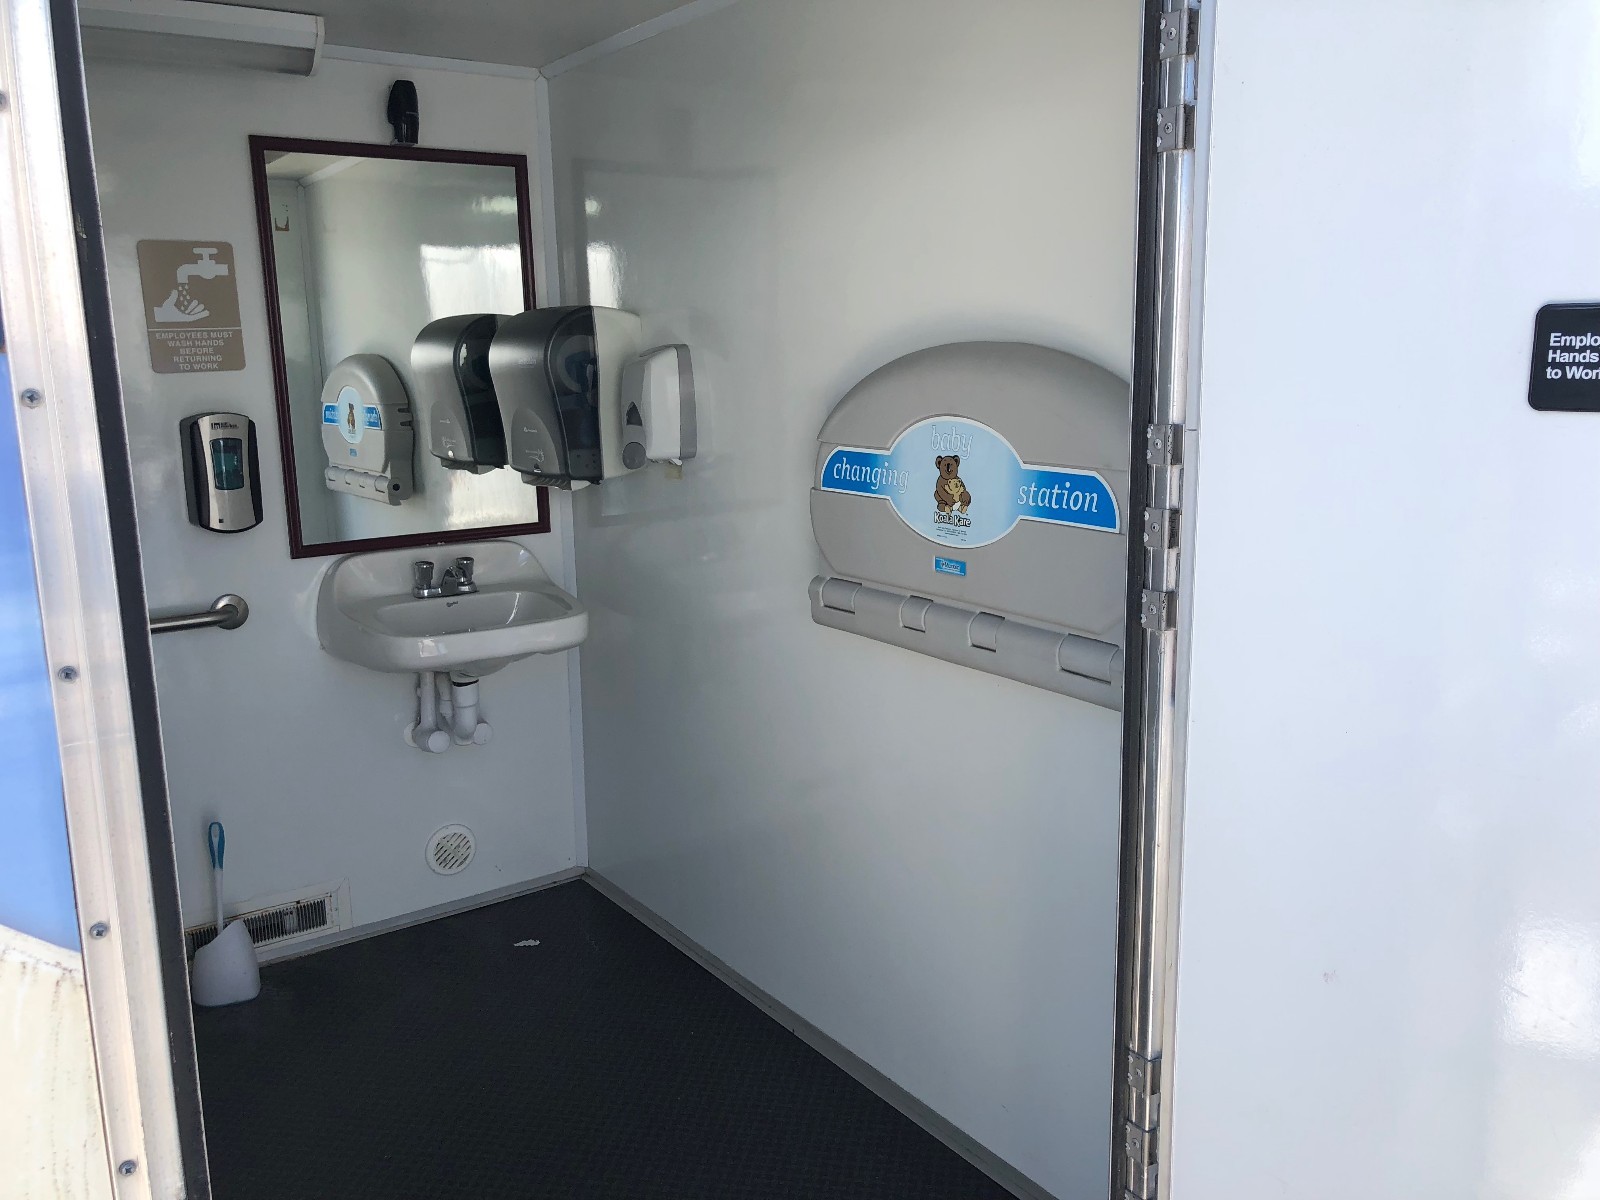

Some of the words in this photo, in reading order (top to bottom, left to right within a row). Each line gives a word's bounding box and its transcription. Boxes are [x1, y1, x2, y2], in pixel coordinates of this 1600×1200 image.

[1550, 333, 1600, 349] Emplo
[173, 354, 222, 362] RETURNING
[1548, 350, 1599, 362] Hands
[1545, 366, 1562, 379] to
[1565, 365, 1600, 380] Wor
[931, 424, 974, 460] baby
[833, 456, 909, 493] changing
[1017, 482, 1098, 513] station
[934, 511, 953, 525] Koala
[953, 514, 971, 527] Kare
